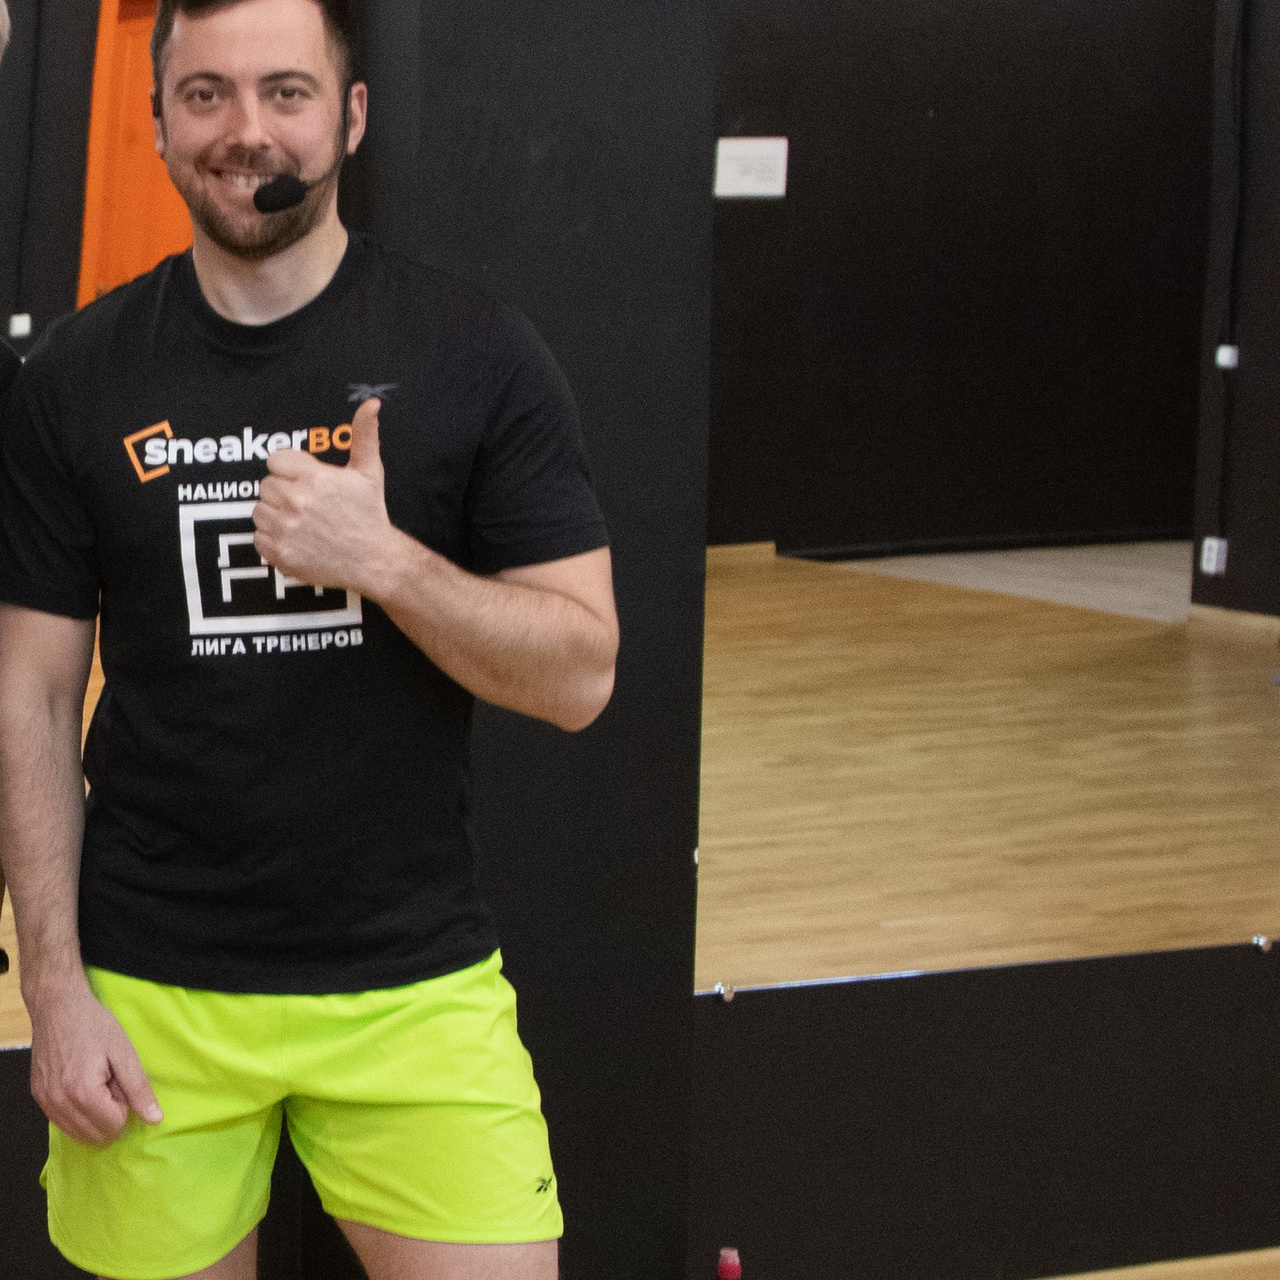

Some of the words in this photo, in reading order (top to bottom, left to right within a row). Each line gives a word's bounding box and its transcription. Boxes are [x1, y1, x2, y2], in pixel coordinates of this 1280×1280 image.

[144, 423, 353, 465] sneakerBO
[191, 637, 246, 656] ЛИГА
[252, 628, 363, 654] ТРЕНЕРОВ
